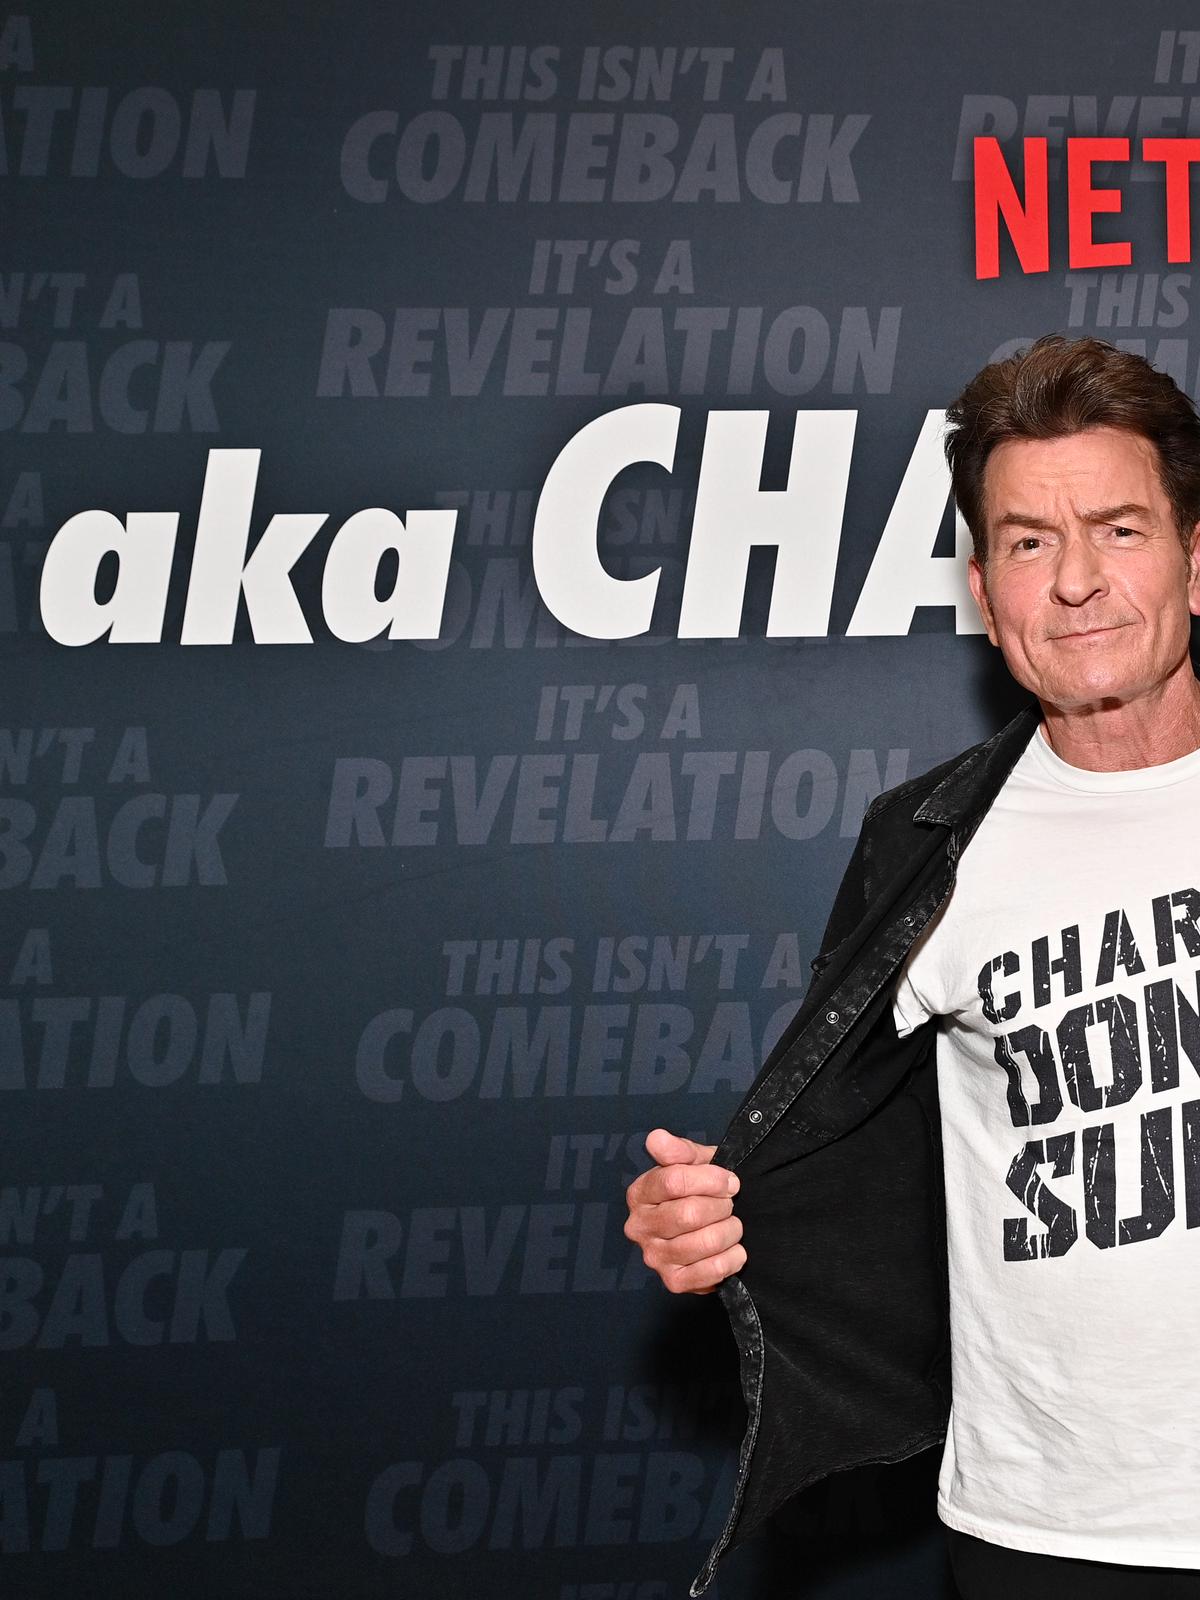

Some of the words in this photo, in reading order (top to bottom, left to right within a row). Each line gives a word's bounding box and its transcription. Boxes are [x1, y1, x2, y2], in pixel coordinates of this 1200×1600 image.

[428, 45, 560, 101] THIS
[579, 46, 735, 101] ISN'T
[747, 48, 787, 101] A
[0, 85, 257, 178] TION
[339, 110, 871, 204] COMEBACK
[529, 239, 640, 295] IT'S
[654, 240, 694, 294] A
[100, 273, 142, 329] A
[1064, 273, 1191, 328] THIS
[316, 305, 903, 398] REVELATION
[37, 446, 460, 649] aka
[536, 684, 647, 741] IT'S
[661, 684, 701, 739] A
[106, 726, 150, 783] A
[324, 748, 908, 847] REVELATION
[11, 929, 52, 984] A
[443, 938, 574, 996] THIS
[592, 934, 750, 993] ISN'T
[760, 931, 802, 990] A
[355, 1000, 804, 1102] COMEBA
[114, 1181, 158, 1240] A
[15, 1388, 58, 1446] A
[452, 1387, 585, 1447] THIS
